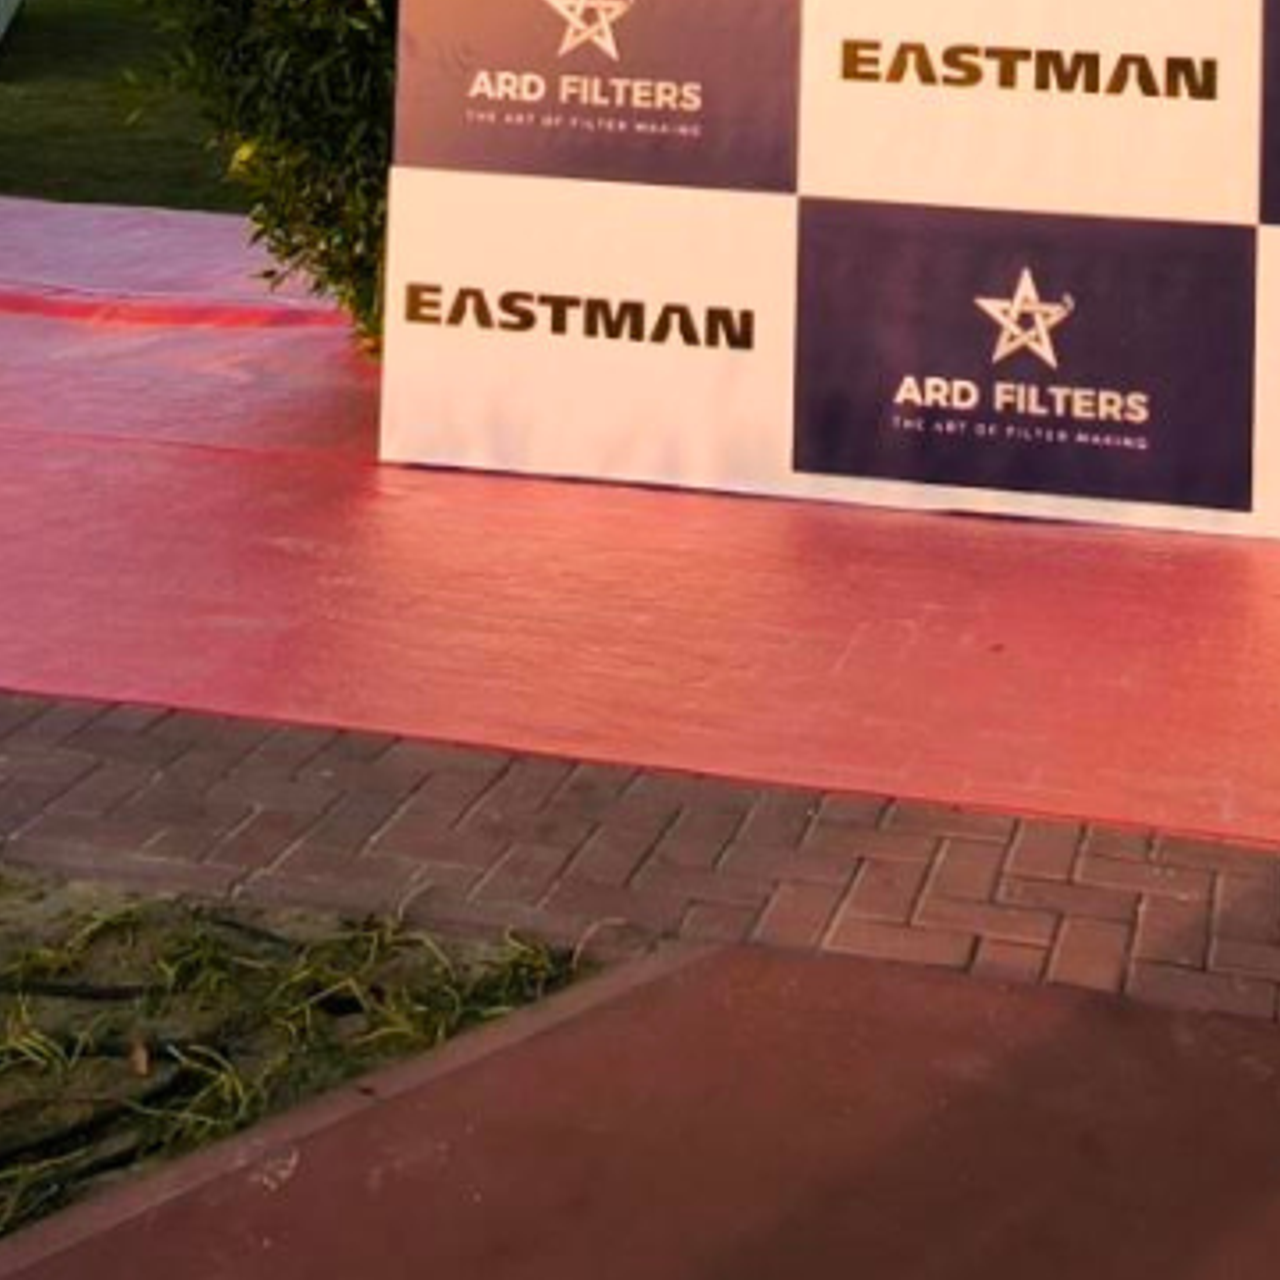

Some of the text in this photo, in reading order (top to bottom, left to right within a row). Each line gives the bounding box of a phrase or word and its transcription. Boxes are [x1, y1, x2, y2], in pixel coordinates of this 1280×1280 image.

[468, 70, 703, 111] ARD FILTERS
[842, 40, 1217, 100] EASTMAN
[406, 284, 754, 350] EASTMAN
[894, 376, 1150, 423] ARD FILTERS
